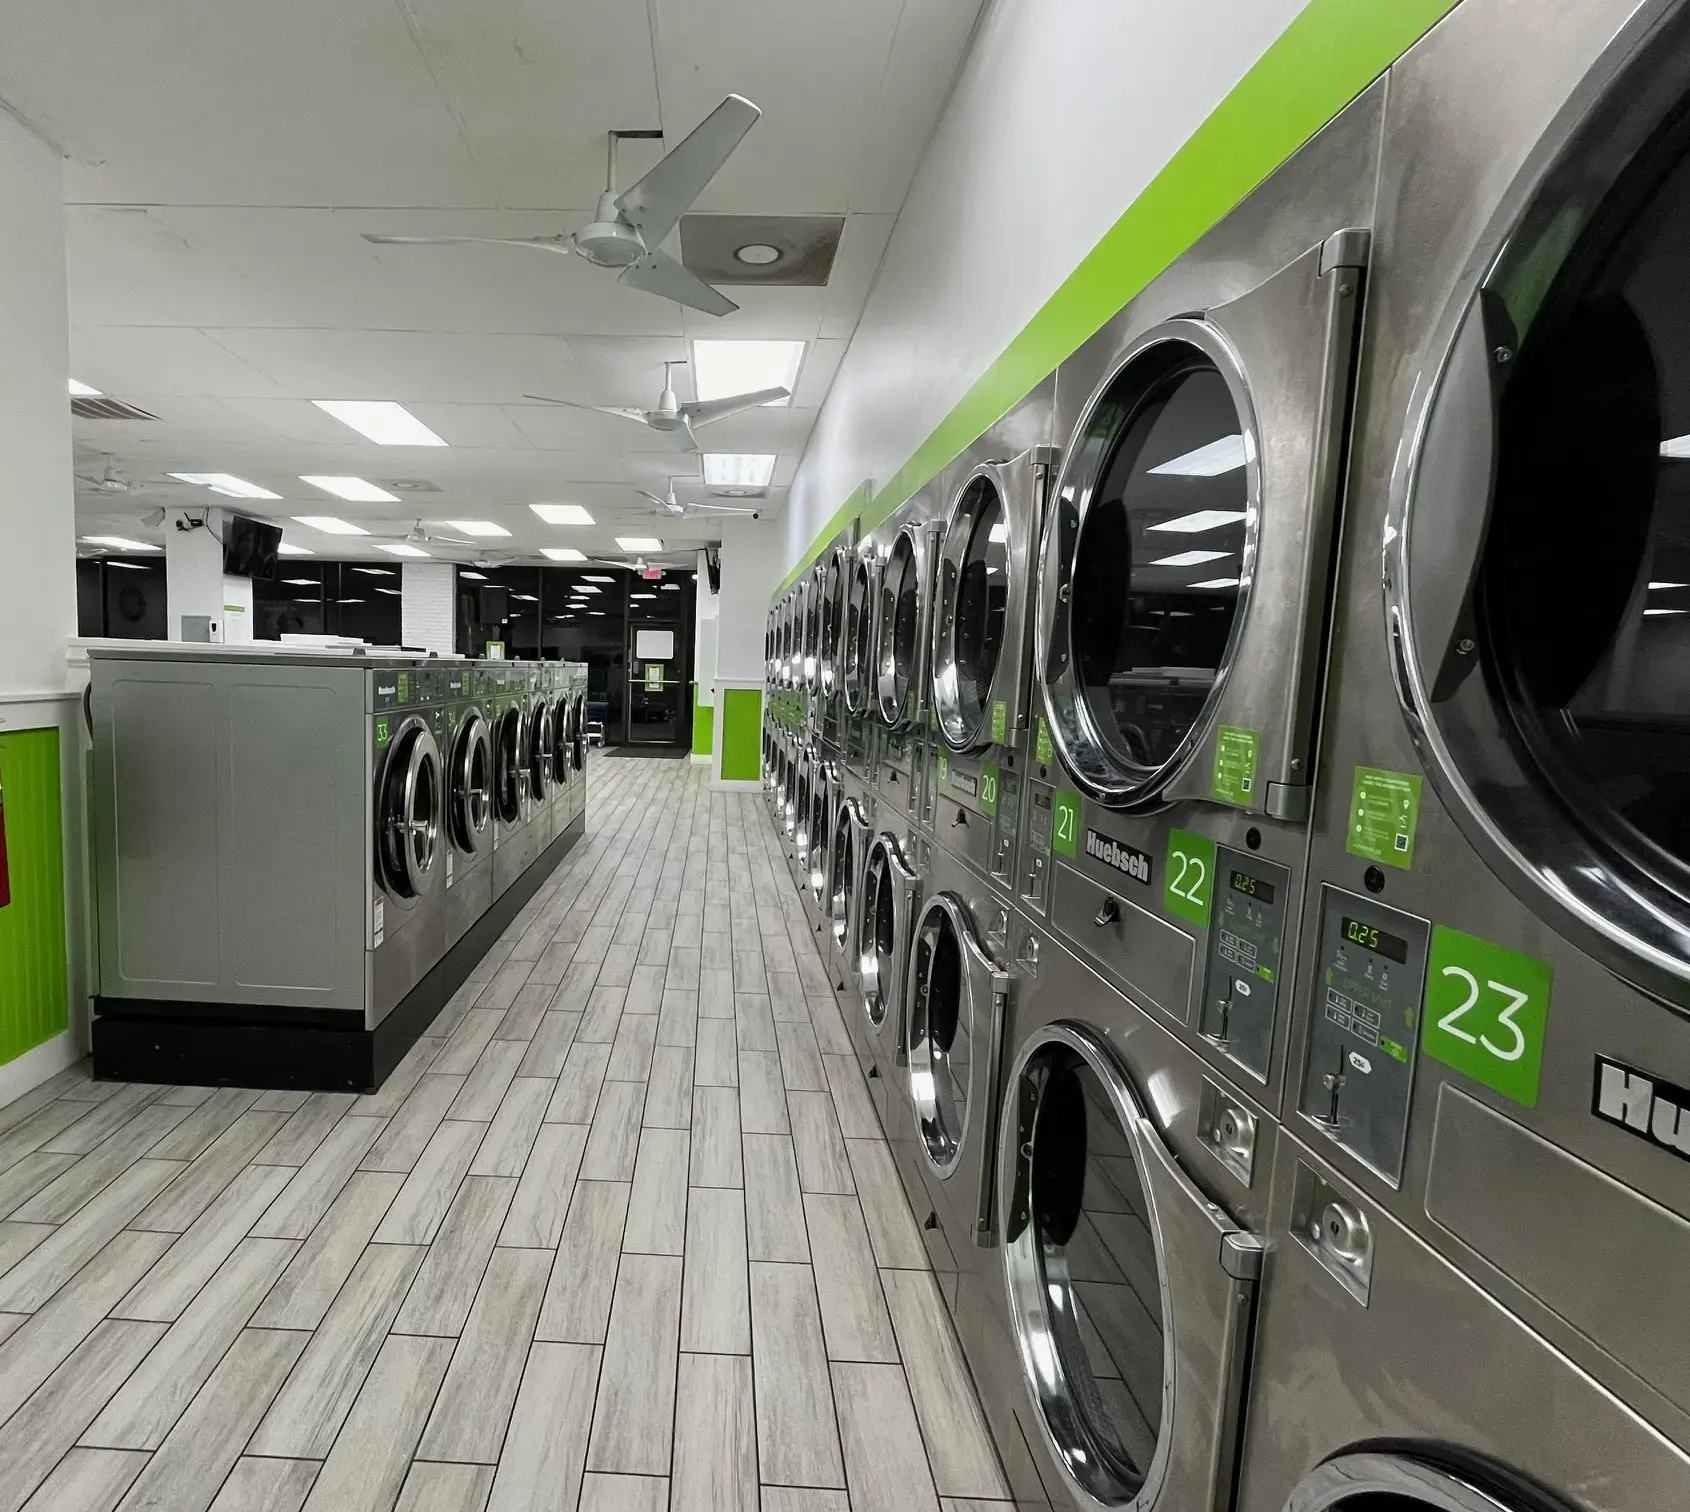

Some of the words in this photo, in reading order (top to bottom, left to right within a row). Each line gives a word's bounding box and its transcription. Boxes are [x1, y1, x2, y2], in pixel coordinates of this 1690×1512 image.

[377, 724, 388, 741] 33
[982, 774, 996, 803] 20
[1057, 805, 1074, 842] 21
[1086, 829, 1150, 883] Huebsch
[1169, 850, 1206, 907] 22
[1347, 921, 1380, 949] 0.25
[1437, 965, 1529, 1061] 23
